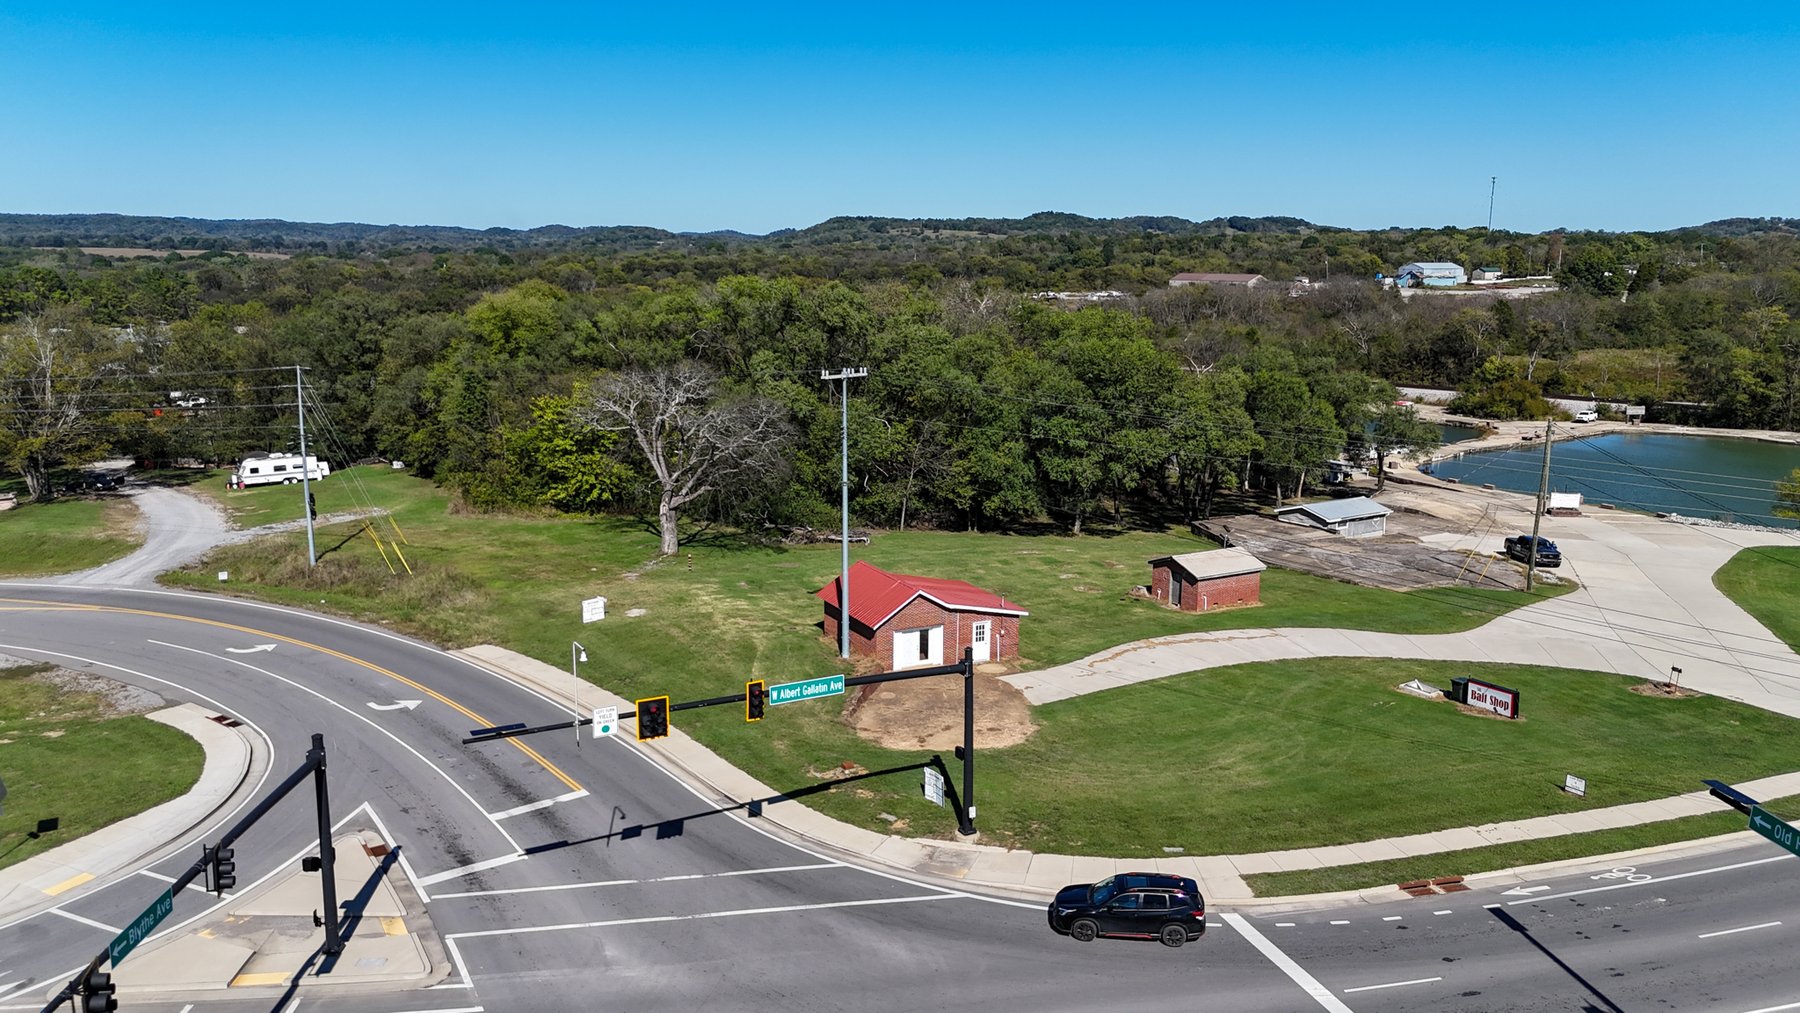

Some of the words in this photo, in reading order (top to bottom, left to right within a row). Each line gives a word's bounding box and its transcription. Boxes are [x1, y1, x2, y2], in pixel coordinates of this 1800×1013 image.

[772, 690, 778, 700] W
[780, 687, 800, 700] Albert
[802, 683, 828, 696] Gallatin
[830, 680, 842, 692] Ave
[1470, 690, 1488, 704] Bait
[1490, 695, 1510, 711] Shop
[1774, 824, 1792, 846] Old
[128, 914, 154, 944] Blythe
[156, 898, 170, 919] Ave
